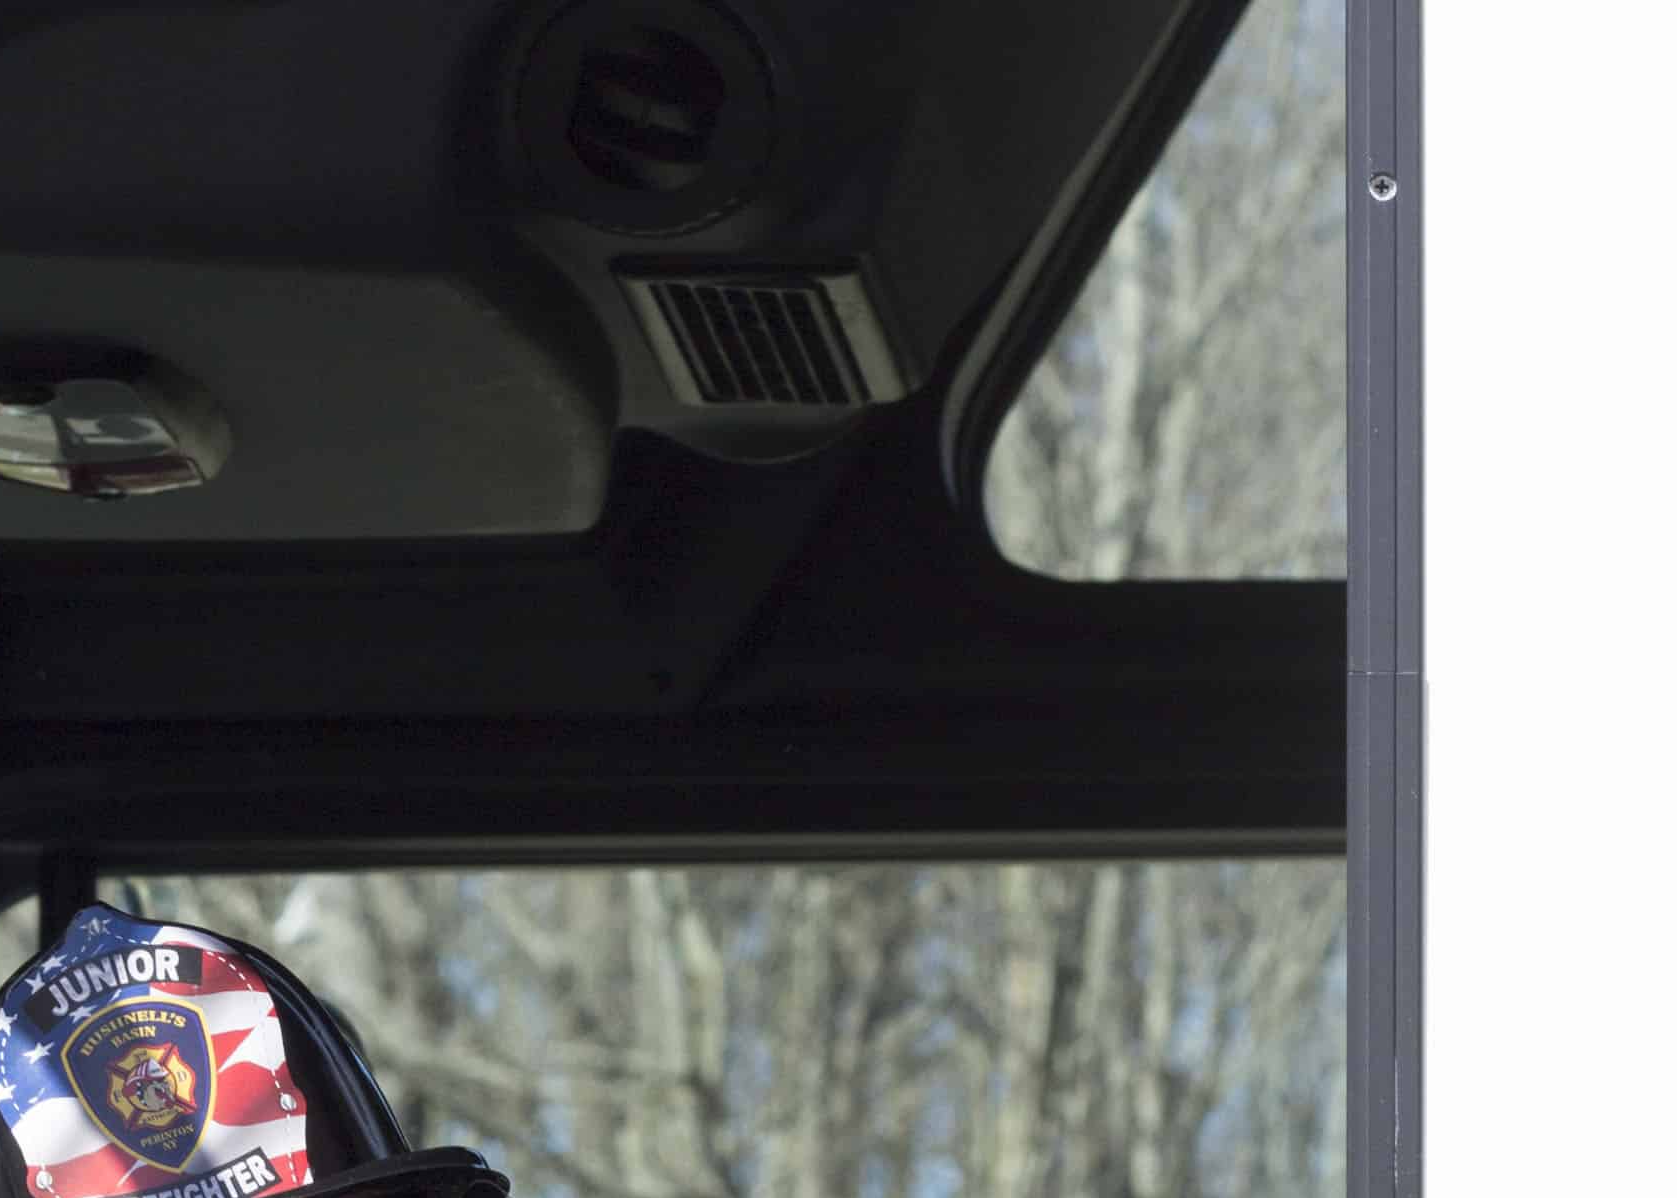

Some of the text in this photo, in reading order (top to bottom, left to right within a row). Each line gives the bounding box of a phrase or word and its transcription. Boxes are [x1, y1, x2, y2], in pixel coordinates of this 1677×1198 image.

[49, 949, 180, 1016] JUNIOR
[80, 1010, 187, 1057] BUSHNELL'S
[110, 1025, 157, 1049] BASIN
[140, 1123, 196, 1148] PERINTON
